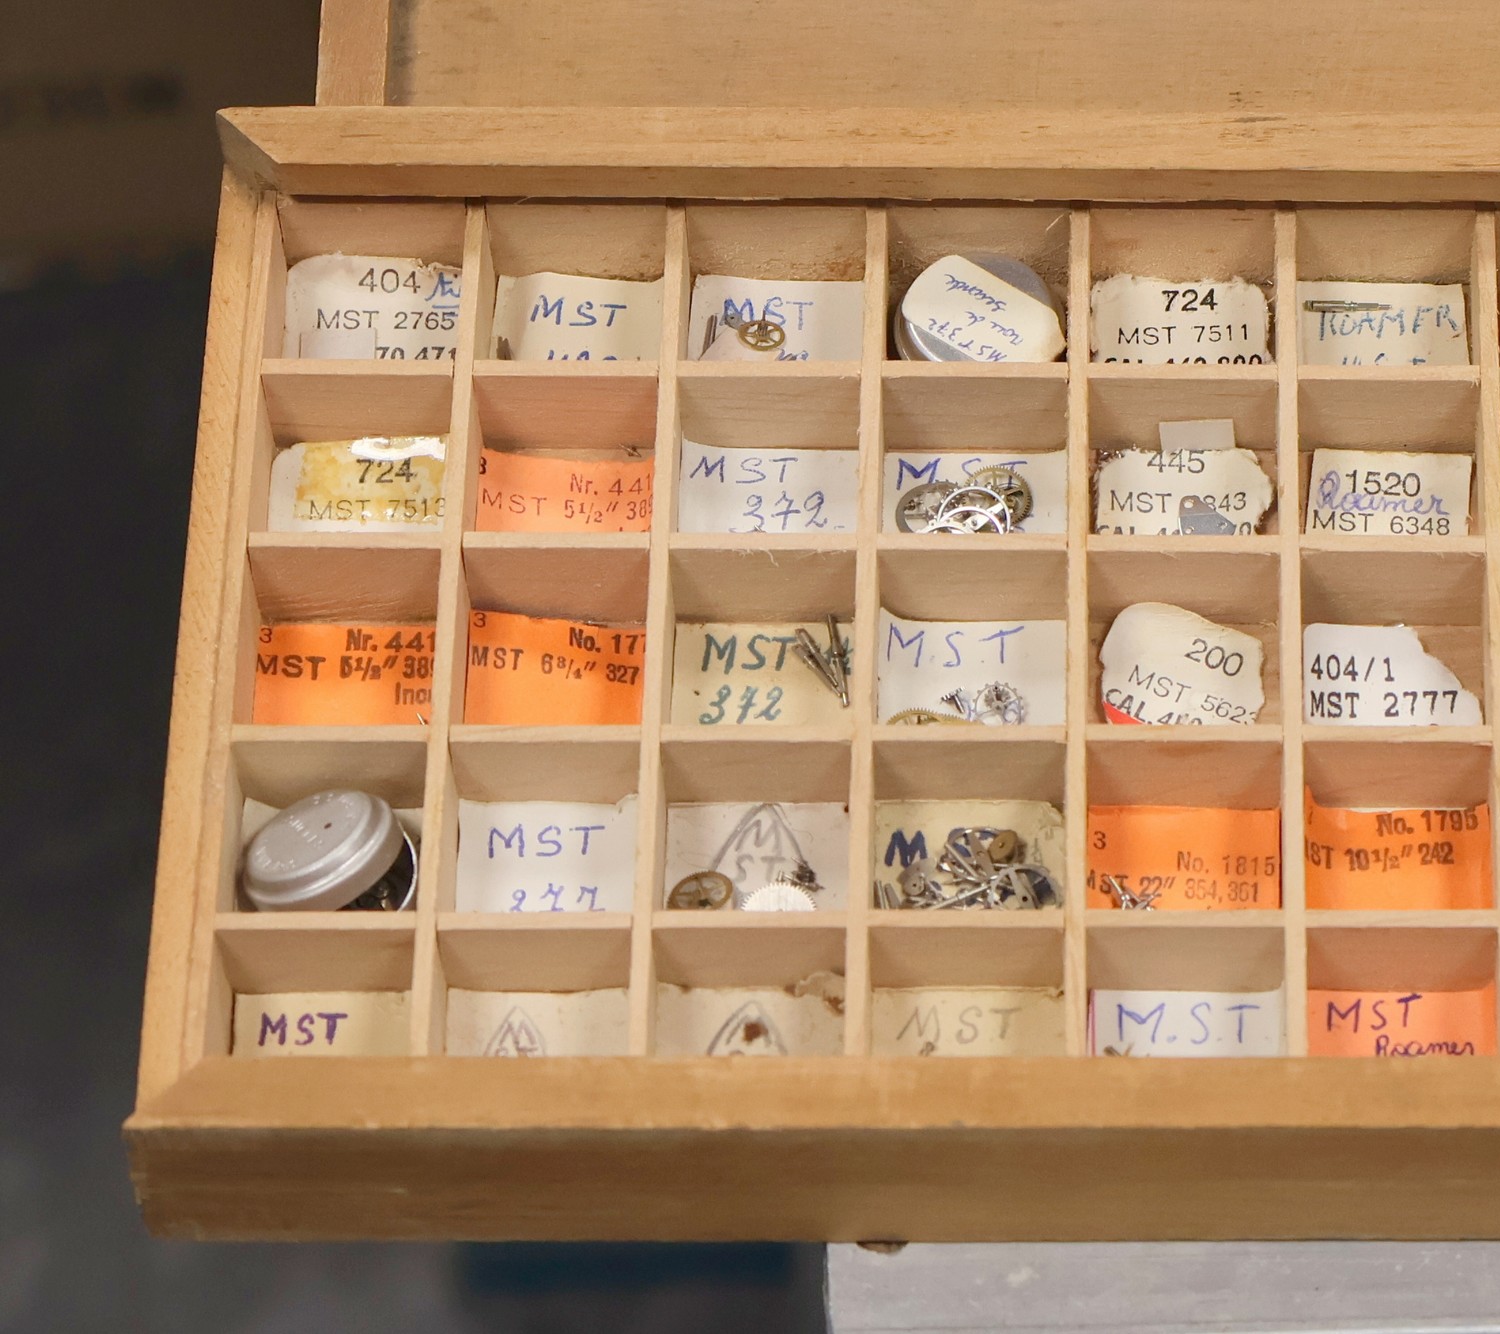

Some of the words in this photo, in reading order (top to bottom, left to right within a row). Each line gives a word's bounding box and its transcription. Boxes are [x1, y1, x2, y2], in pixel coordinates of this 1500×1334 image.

[359, 268, 421, 294] 404
[531, 295, 627, 327] MST
[1162, 288, 1218, 312] 724
[316, 309, 379, 330] MST
[394, 311, 455, 331] 2765
[723, 298, 813, 331] MST
[1118, 326, 1176, 345] MST
[1193, 323, 1249, 343] 7511
[356, 458, 413, 484] 724
[690, 455, 798, 484] MST
[1147, 449, 1205, 474] 445
[569, 474, 598, 496] Nr.
[1345, 471, 1420, 496] 1520
[309, 500, 371, 520] MST
[482, 488, 547, 515] MST
[1110, 490, 1172, 513] MST
[1312, 512, 1374, 533] MST
[1390, 516, 1450, 535] 6348
[473, 613, 486, 627] 3
[259, 627, 272, 644] 3
[346, 628, 378, 652] Nr.
[385, 631, 436, 652] 441
[569, 627, 601, 652] No.
[471, 646, 524, 671] MST
[606, 664, 640, 684] 327
[702, 633, 796, 674] MST
[1184, 638, 1244, 677] 200
[256, 655, 326, 681] MST
[1310, 655, 1395, 682] 404/1
[1129, 665, 1191, 704] MST
[1310, 692, 1359, 718] MST
[1385, 690, 1458, 718] 2777
[1376, 814, 1414, 837] No.
[1423, 810, 1478, 833] 1795
[487, 823, 605, 859] MST
[1093, 831, 1106, 850] 3
[1419, 842, 1454, 865] 242
[1177, 851, 1209, 873] No.
[1223, 855, 1275, 876] 1815
[897, 1006, 1022, 1044] MST
[1327, 993, 1423, 1033] MST
[258, 1012, 348, 1047] MST
